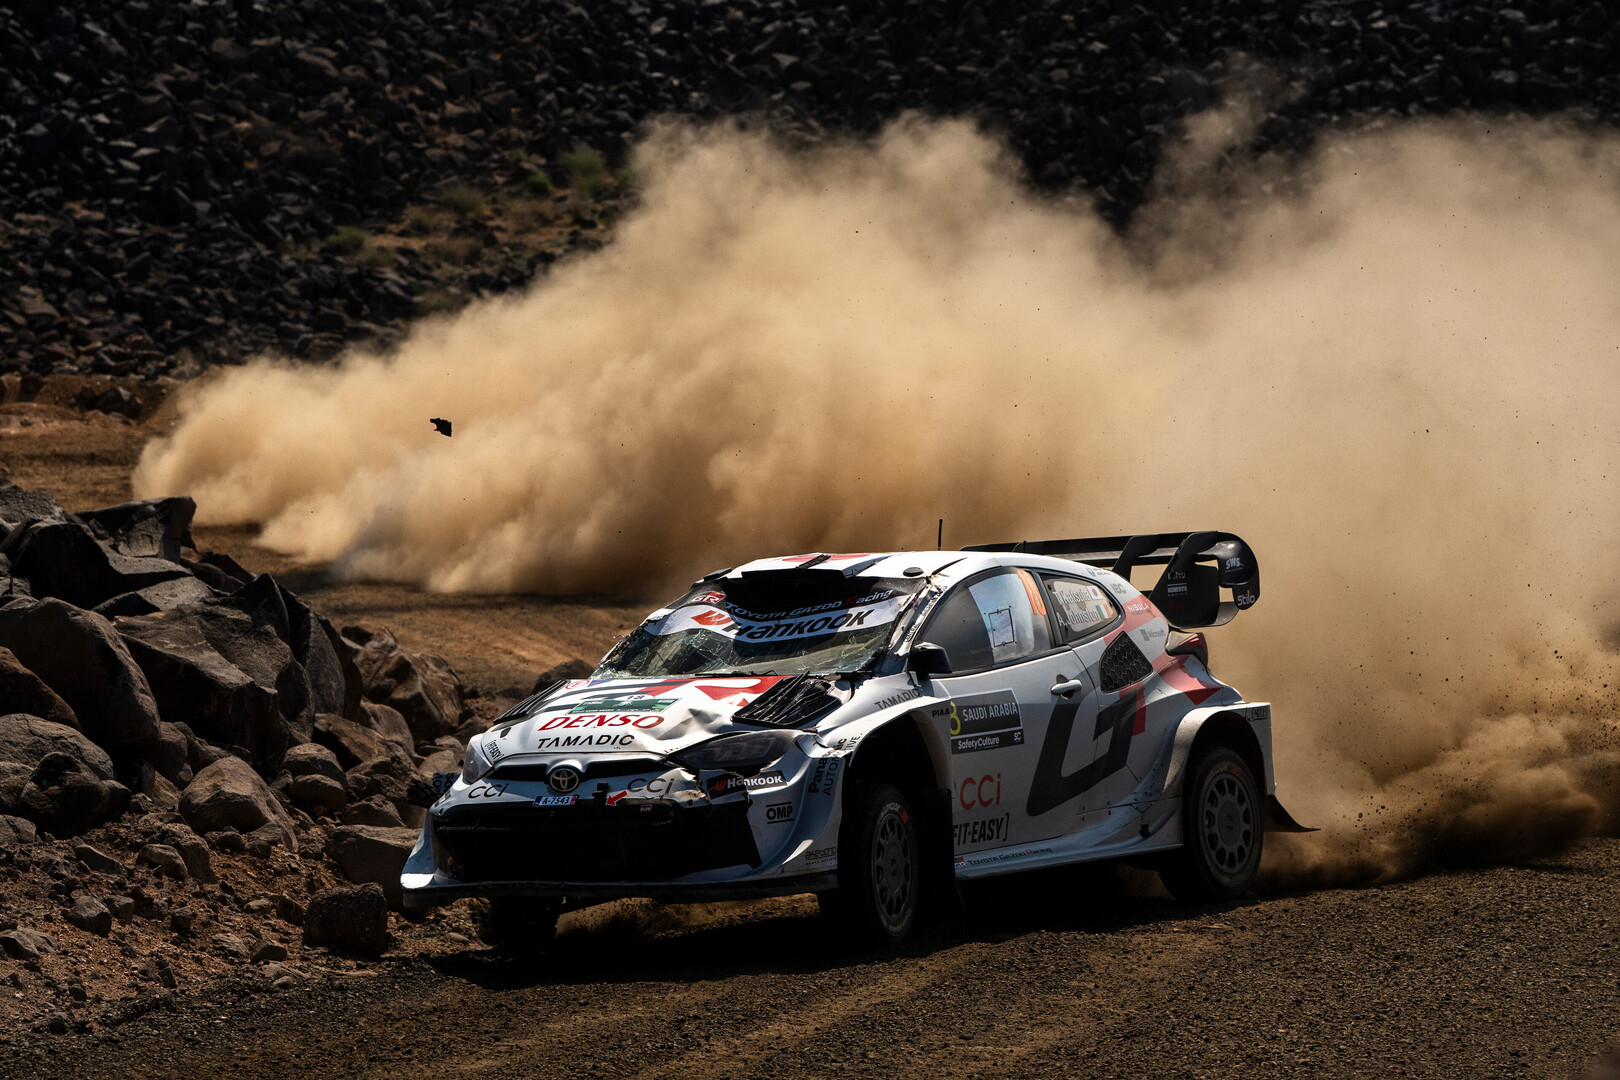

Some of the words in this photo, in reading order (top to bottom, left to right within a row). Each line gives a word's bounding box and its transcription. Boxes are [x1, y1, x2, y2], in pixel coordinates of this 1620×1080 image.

[1225, 557, 1240, 570] SWS
[1017, 569, 1046, 616] 18
[1237, 587, 1256, 607] Stilo
[788, 600, 843, 616] GAZOO
[845, 589, 893, 606] Racing
[932, 707, 950, 718] PIAA
[962, 706, 988, 722] SAUDI
[988, 702, 1018, 718] ARABIA
[537, 714, 665, 732] DENSO
[538, 734, 635, 749] TAMADIC
[957, 736, 1000, 750] SafetyCulture
[727, 774, 783, 789] Hankook
[541, 796, 569, 805] A-7543
[766, 804, 794, 821] OMP
